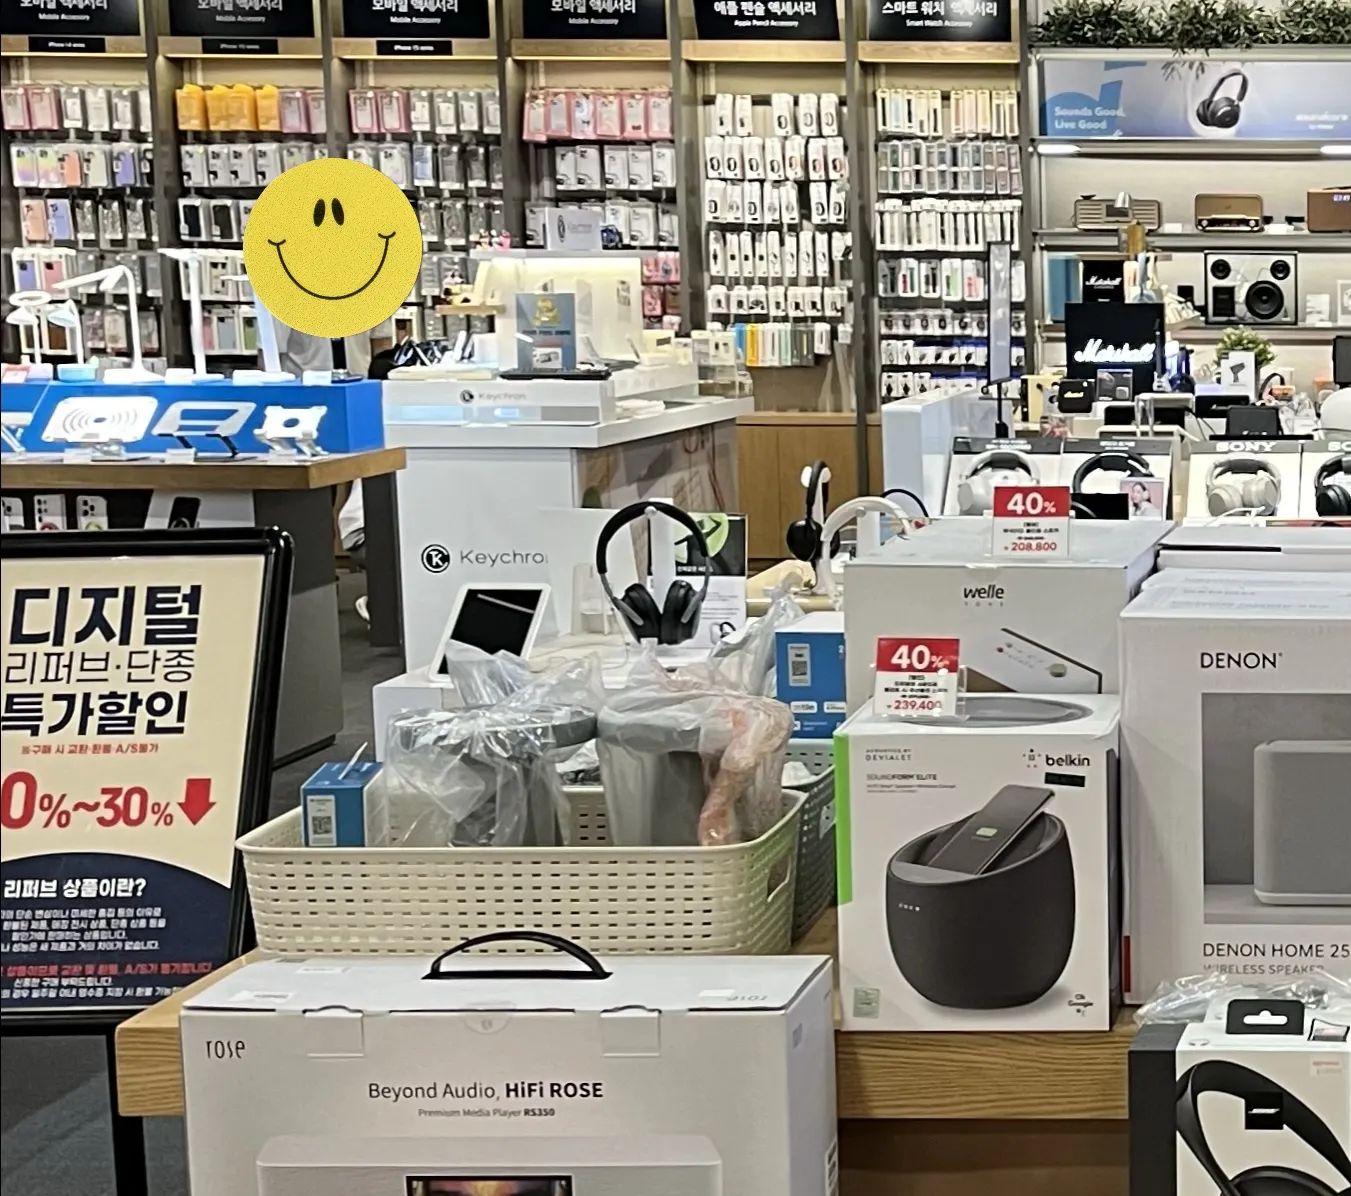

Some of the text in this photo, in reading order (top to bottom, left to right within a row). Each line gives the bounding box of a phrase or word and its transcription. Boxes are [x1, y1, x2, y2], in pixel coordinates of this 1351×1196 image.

[714, 1, 817, 15] 애플 펜슬 액세서리
[882, 1, 918, 15] 스마트
[920, 1, 945, 15] 워치
[1054, 105, 1092, 116] Sounds
[1054, 119, 1107, 130] Live Good
[1074, 338, 1156, 363] Marshall
[1216, 441, 1276, 452] SONY
[1006, 491, 1057, 515] 40%
[963, 584, 1005, 600] welle
[9, 584, 202, 647] 디지털
[891, 644, 945, 670] 40%
[1200, 652, 1278, 669] DENON
[5, 649, 195, 684] 리퍼브·단종
[1, 690, 188, 737] 특가할인
[1045, 753, 1091, 767] belkin
[4, 878, 146, 898] 리퍼브 상품이란?
[1202, 942, 1266, 958] DENON
[1271, 942, 1325, 958] HOME
[1202, 963, 1266, 975] WIRELESS
[205, 1039, 246, 1060] rose
[368, 1082, 603, 1102] Beyond Audio, HiFi ROSE
[418, 1107, 555, 1119] Premium Media Player RS350
